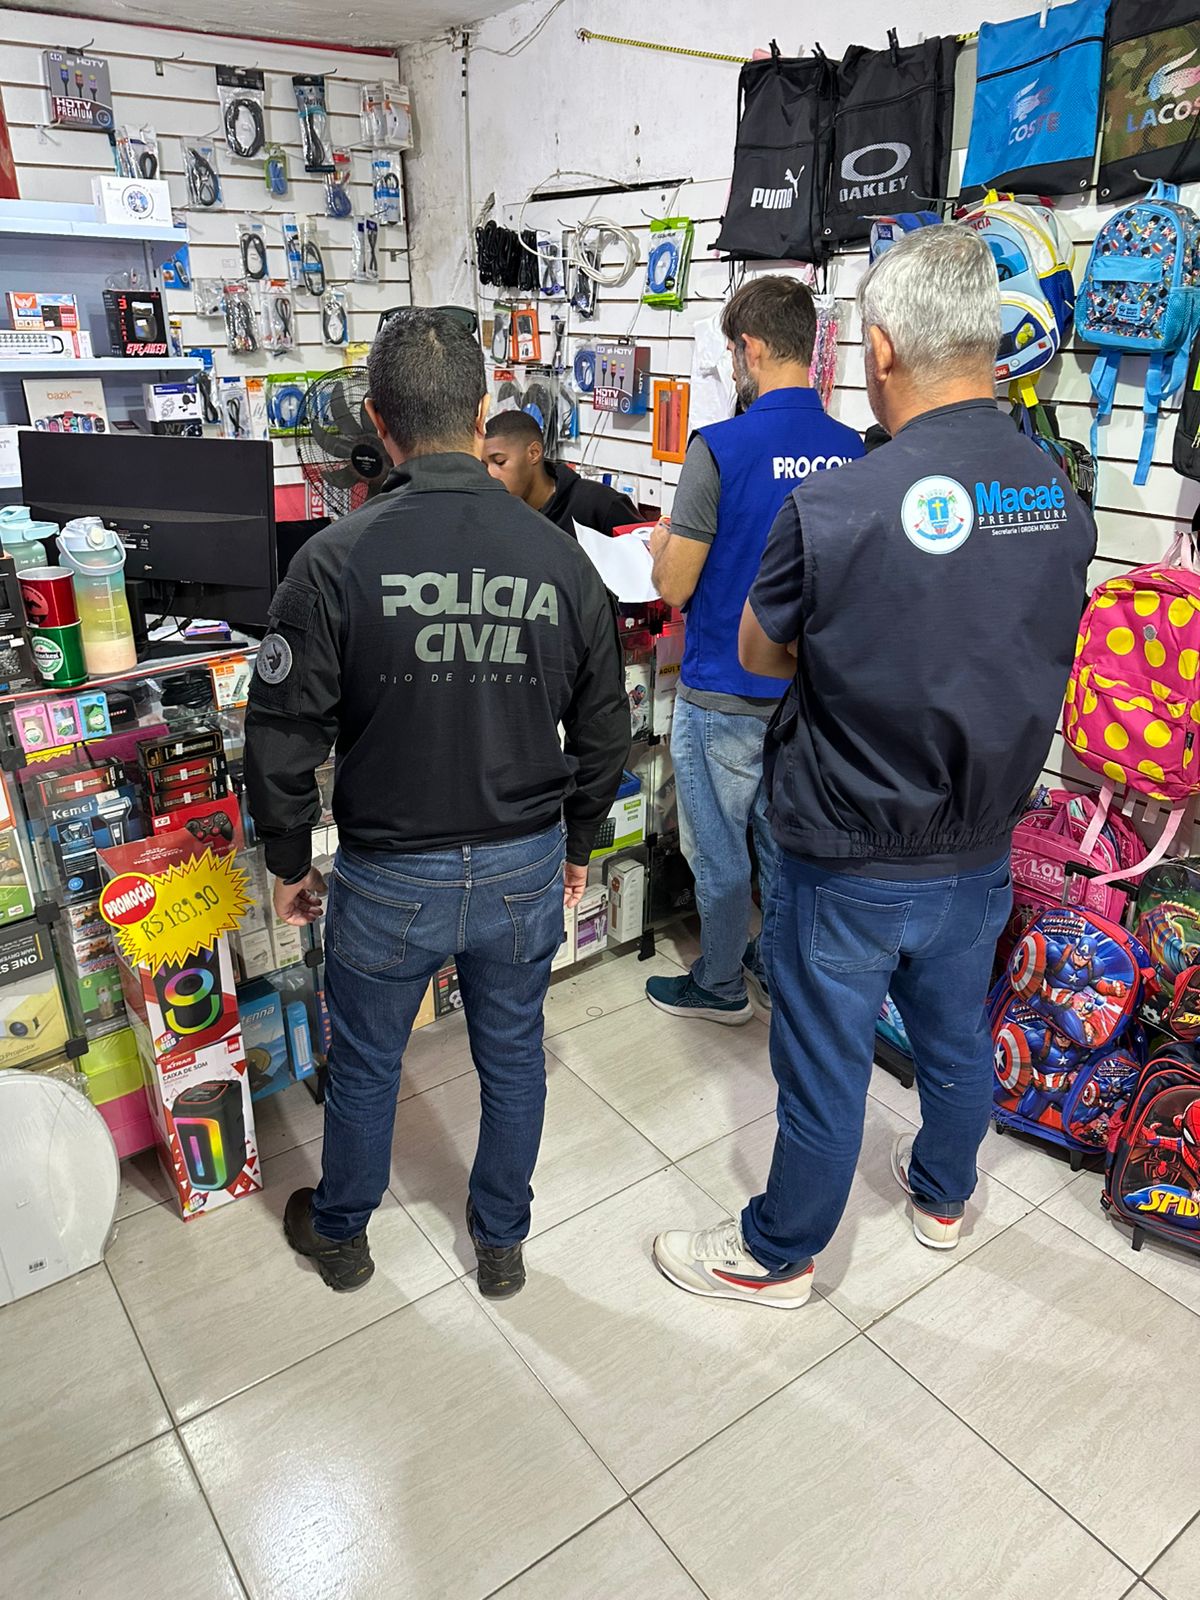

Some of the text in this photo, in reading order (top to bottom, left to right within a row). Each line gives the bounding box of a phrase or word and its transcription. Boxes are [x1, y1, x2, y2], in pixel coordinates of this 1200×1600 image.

[76, 57, 104, 68] HDTV
[56, 97, 91, 110] HDTV
[57, 106, 93, 119] PREMIUM
[839, 175, 909, 203] OAKLEY
[750, 187, 793, 210] PUMA
[126, 343, 167, 356] SPEAKER
[613, 348, 633, 356] HDTV
[595, 388, 619, 398] HDTV
[595, 396, 619, 407] PREMIUM
[772, 456, 853, 479] PROCO
[975, 477, 1065, 515] Macaé
[978, 509, 1068, 526] PREFEITURA
[991, 523, 1060, 536] Secretaria ORDEM PÚBLICA
[381, 568, 559, 626] POLÍCIA
[414, 623, 528, 665] CIVIL
[380, 673, 413, 684] RIO
[431, 672, 453, 683] DE
[1030, 859, 1065, 882] LOL
[104, 880, 155, 919] PROMOÇÃO
[11, 954, 37, 970] ONE
[162, 1070, 182, 1081] CAIXA
[183, 1067, 192, 1076] DE
[193, 1062, 208, 1071] SOM
